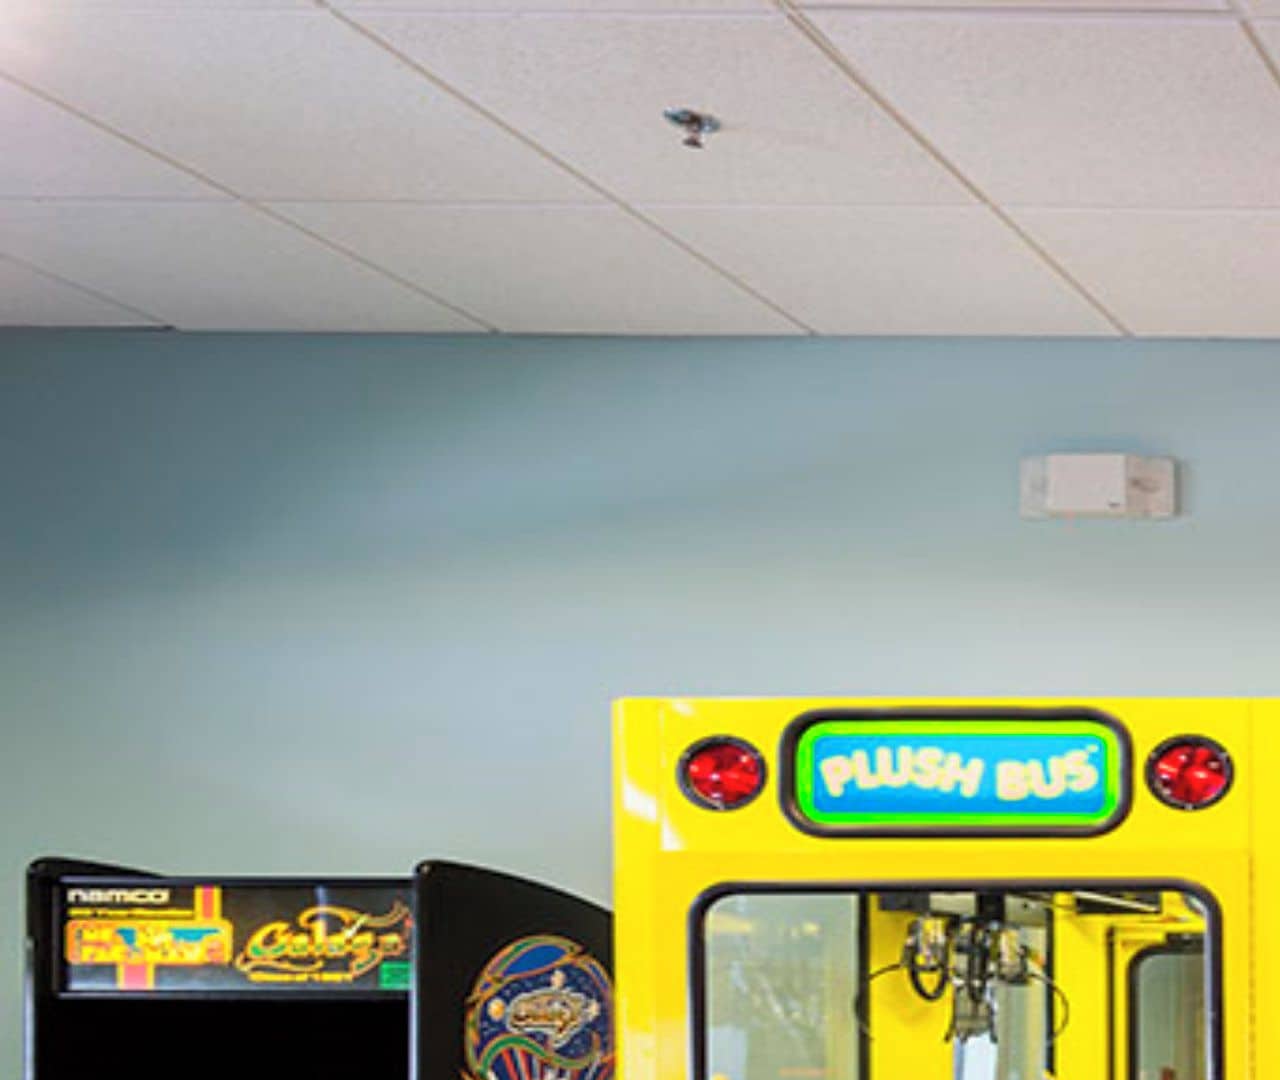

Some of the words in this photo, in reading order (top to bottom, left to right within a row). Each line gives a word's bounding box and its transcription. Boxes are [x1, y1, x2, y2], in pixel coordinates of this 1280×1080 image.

[820, 746, 984, 798] PLUSH
[996, 750, 1099, 801] BUS
[66, 888, 170, 903] namco
